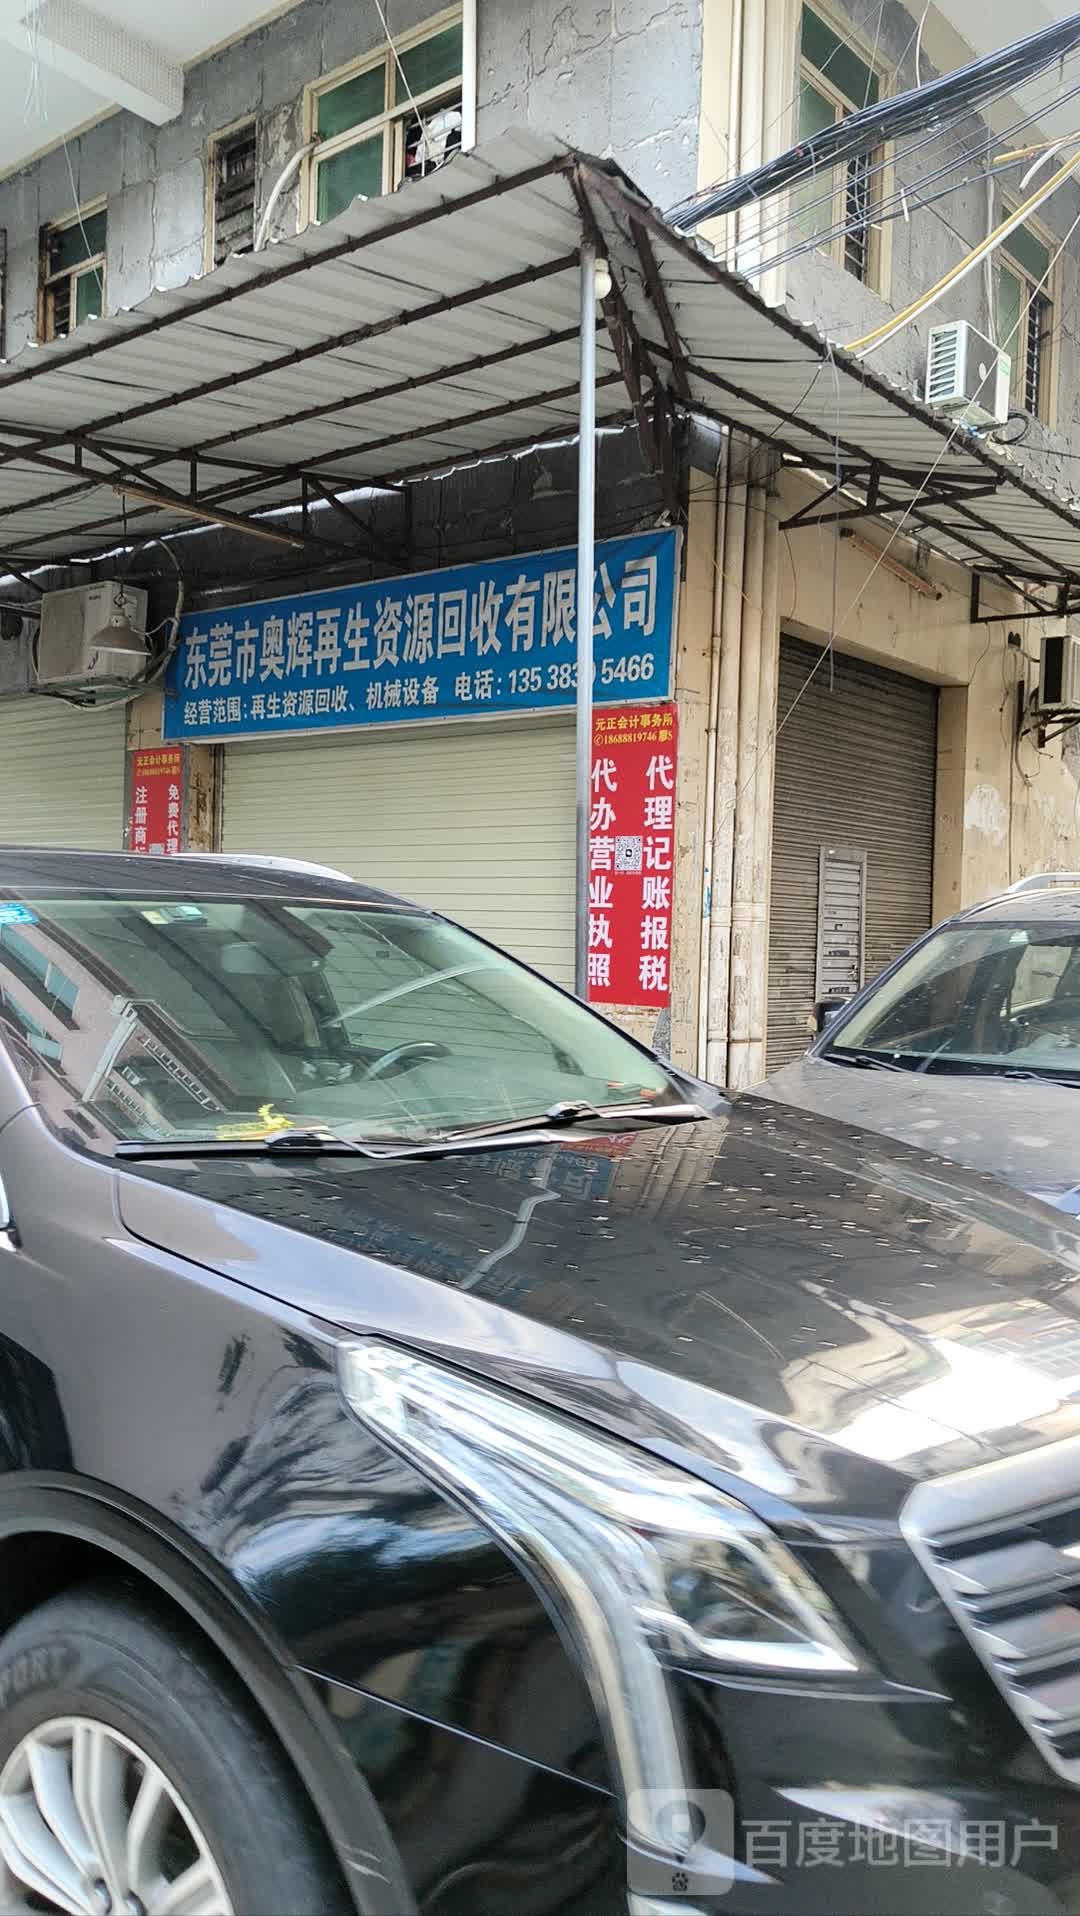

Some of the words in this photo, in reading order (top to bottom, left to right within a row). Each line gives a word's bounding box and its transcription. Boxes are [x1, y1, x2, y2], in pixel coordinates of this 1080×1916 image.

[184, 555, 658, 690] 东莞市奥辉再生资源回收有限公司
[508, 666, 542, 694] 135
[546, 662, 596, 690] 383
[601, 653, 655, 684] 5466
[595, 713, 673, 731] 元正会计事务所
[588, 757, 618, 987] 代办营业执照
[639, 755, 673, 991] 代理记账报税
